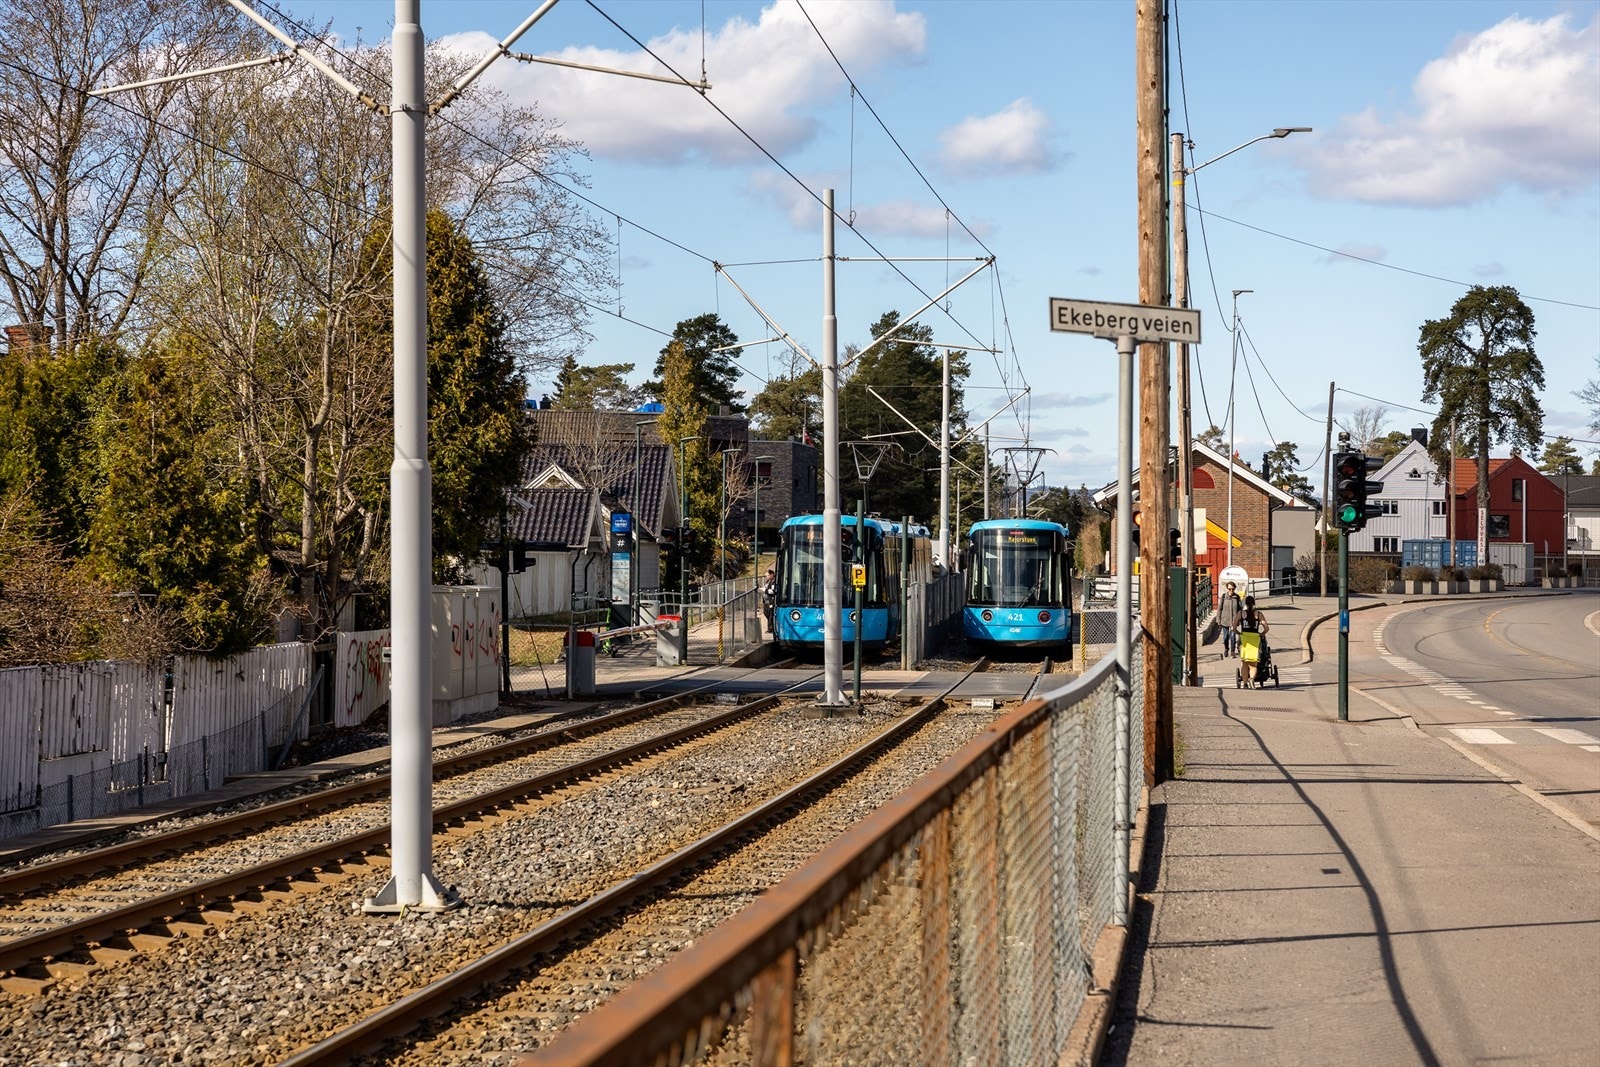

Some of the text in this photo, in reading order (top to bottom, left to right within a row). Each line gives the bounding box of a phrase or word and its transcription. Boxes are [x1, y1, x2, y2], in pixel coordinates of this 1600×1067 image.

[1058, 306, 1192, 335] Ekebergveien
[856, 569, 862, 578] P
[1008, 613, 1023, 621] 421
